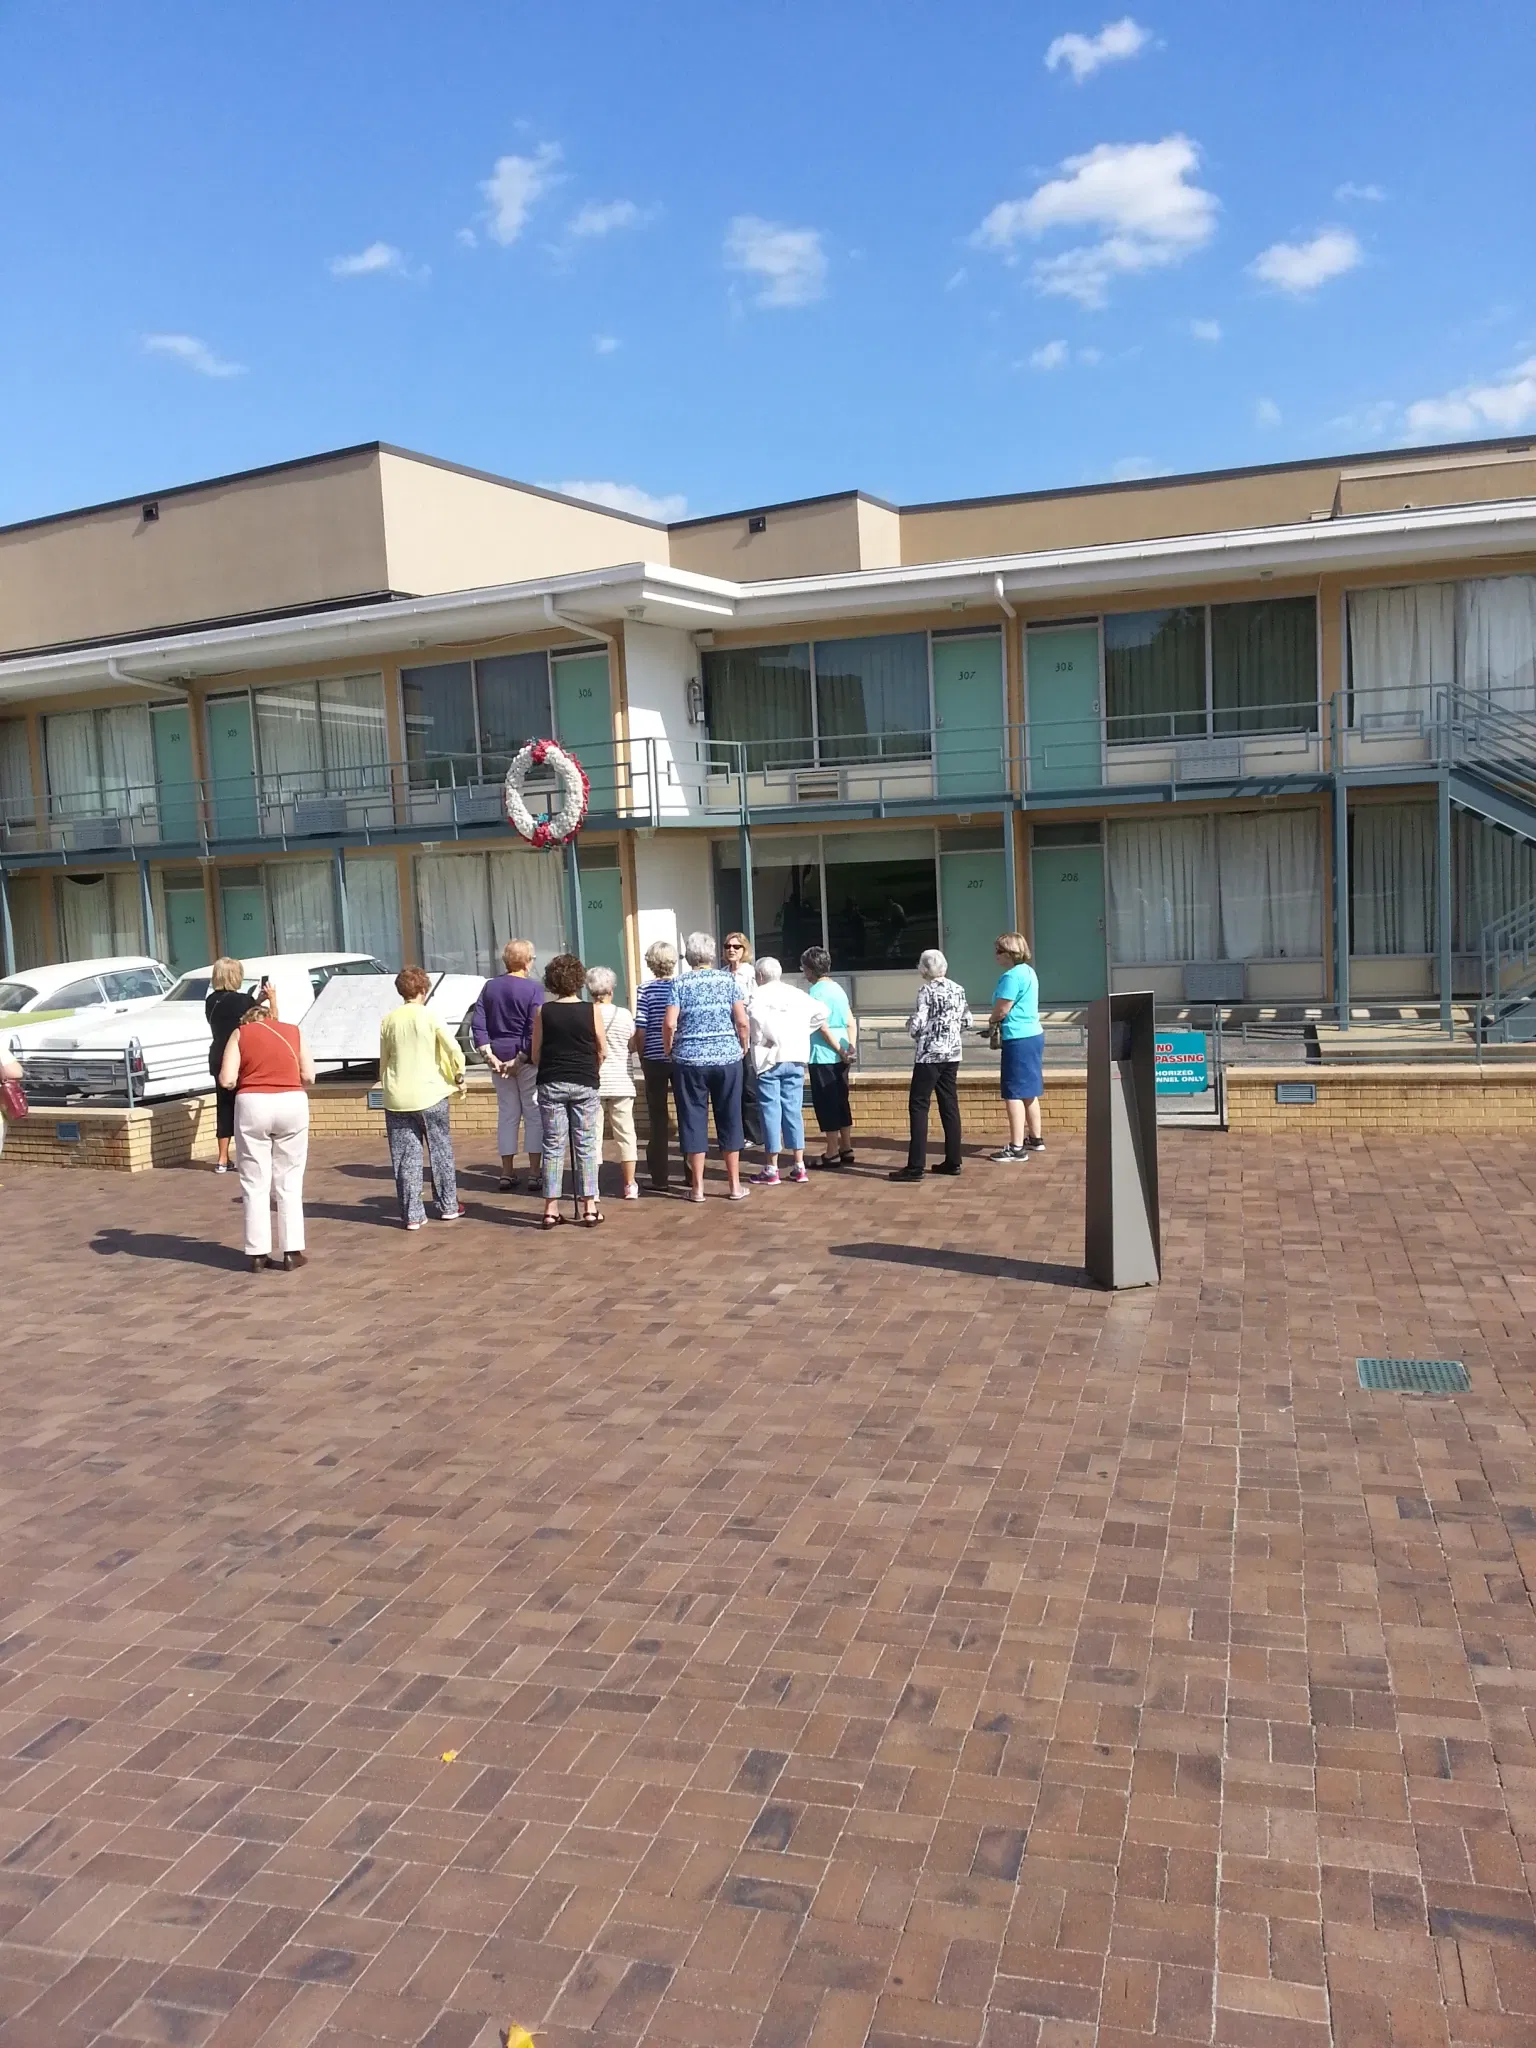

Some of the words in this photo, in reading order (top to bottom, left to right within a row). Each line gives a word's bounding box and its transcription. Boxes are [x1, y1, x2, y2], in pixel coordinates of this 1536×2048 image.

[1055, 662, 1074, 672] 308
[958, 671, 976, 681] 307
[578, 688, 592, 699] 306
[1061, 873, 1079, 882] 208
[967, 879, 984, 889] 207
[588, 900, 603, 909] 206
[1156, 1044, 1173, 1052] NO
[1155, 1054, 1204, 1063] PASSING
